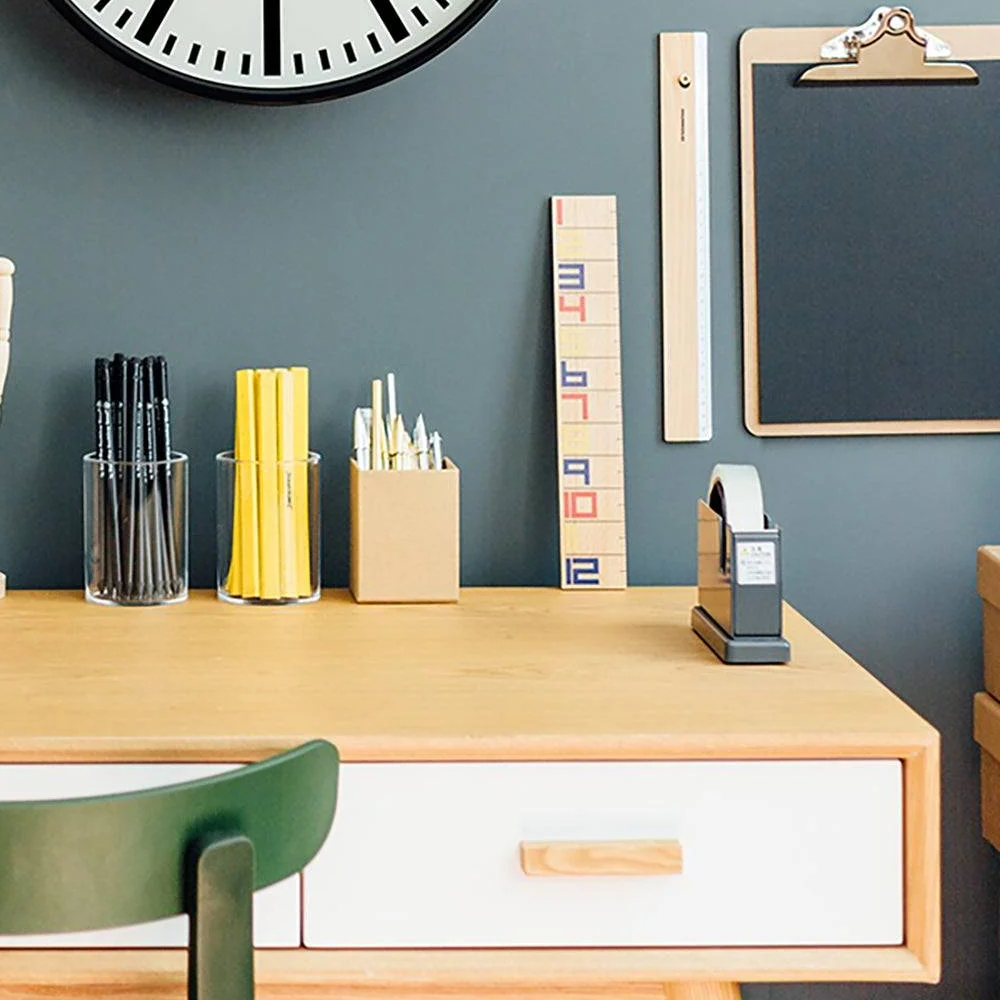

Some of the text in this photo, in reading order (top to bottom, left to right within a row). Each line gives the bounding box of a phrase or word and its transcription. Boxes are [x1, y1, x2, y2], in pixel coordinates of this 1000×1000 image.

[558, 263, 585, 290] 3
[559, 295, 586, 322] 4
[561, 393, 588, 420] 7
[563, 458, 590, 485] 9
[564, 491, 597, 518] 10
[566, 558, 600, 585] 12
